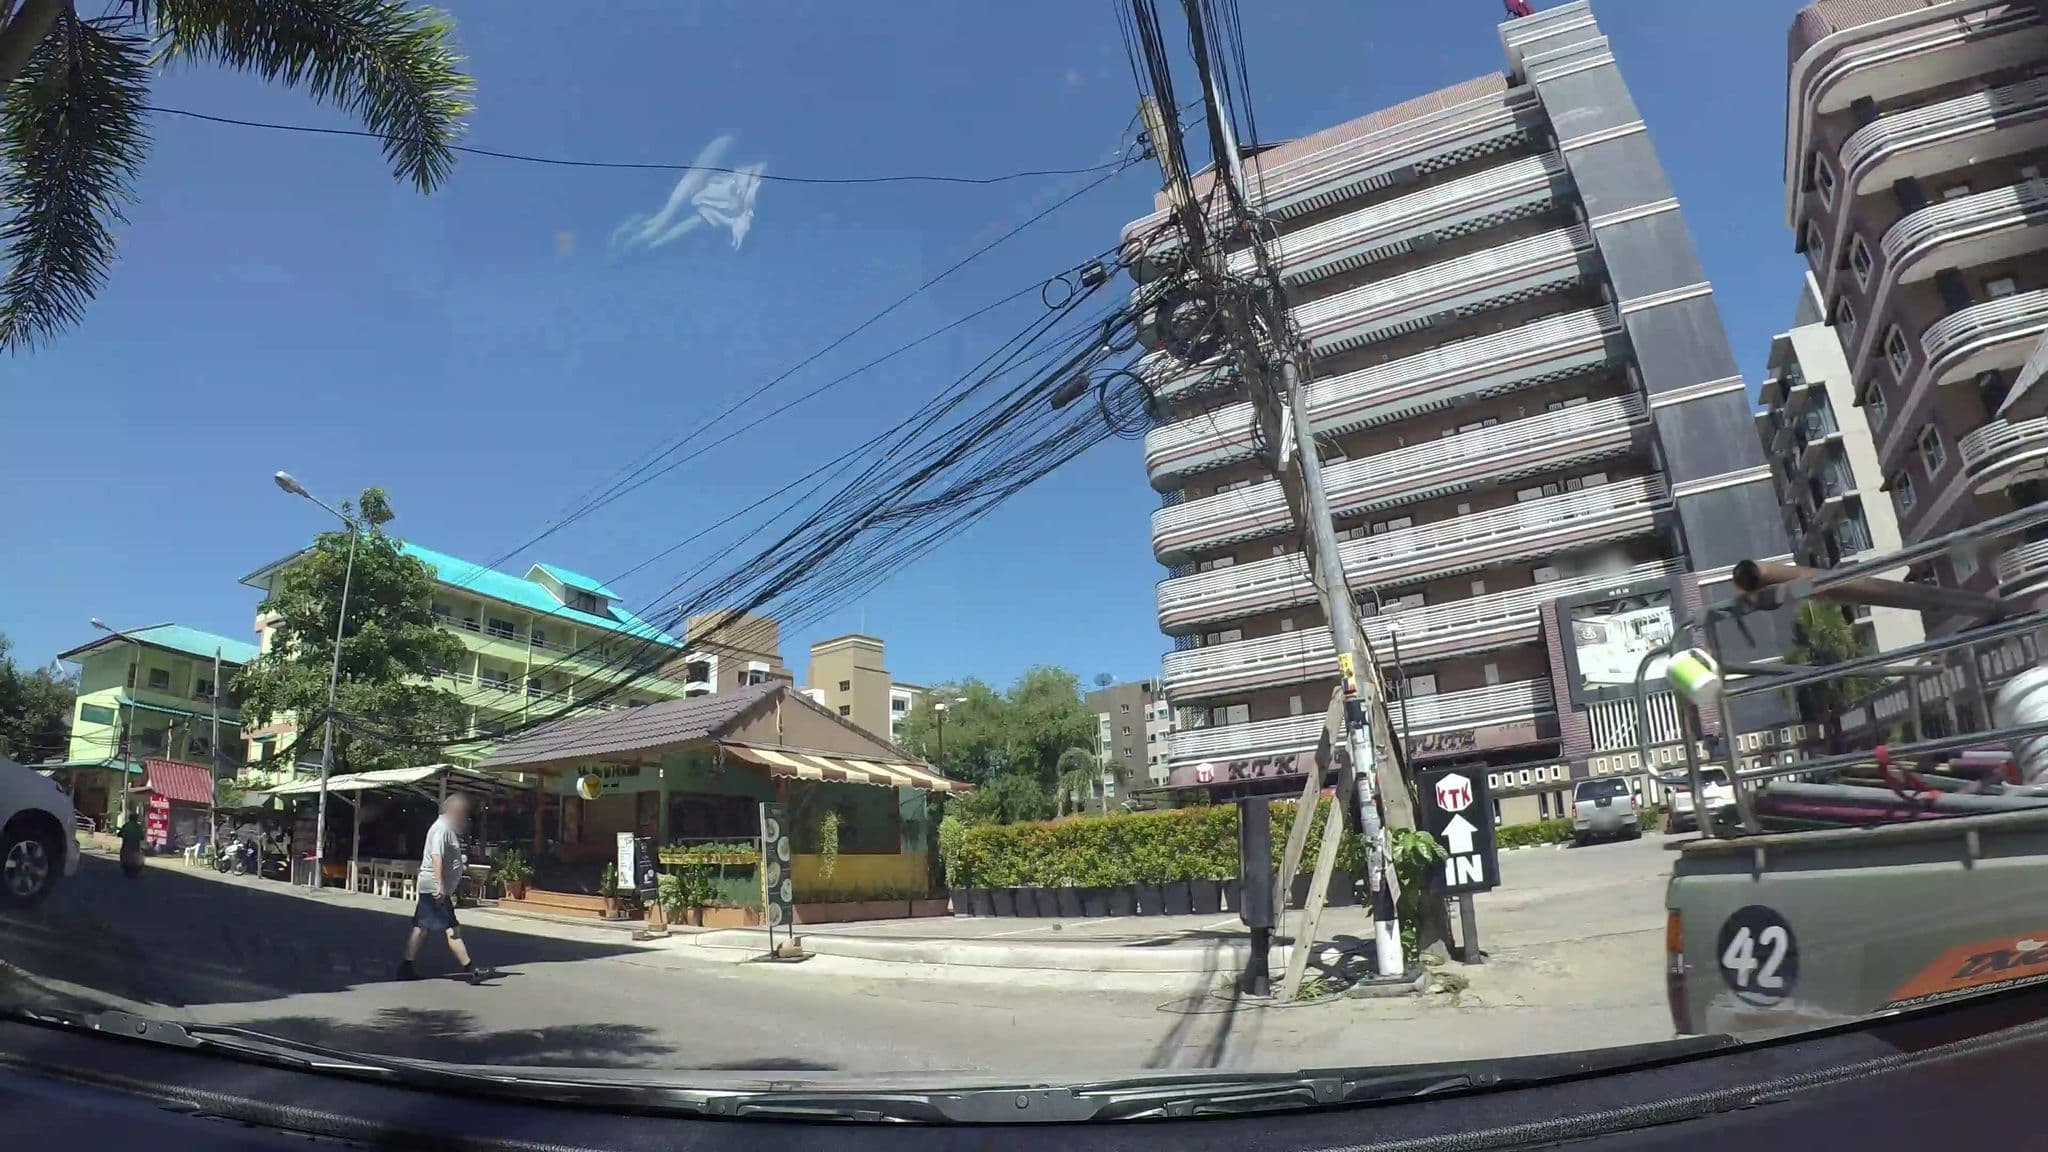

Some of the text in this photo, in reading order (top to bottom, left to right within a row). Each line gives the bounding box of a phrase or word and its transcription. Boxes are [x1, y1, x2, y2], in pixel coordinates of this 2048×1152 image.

[1228, 755, 1298, 780] KTK
[1437, 783, 1471, 810] KTK
[1445, 854, 1484, 886] IN
[1722, 926, 1788, 988] 42
